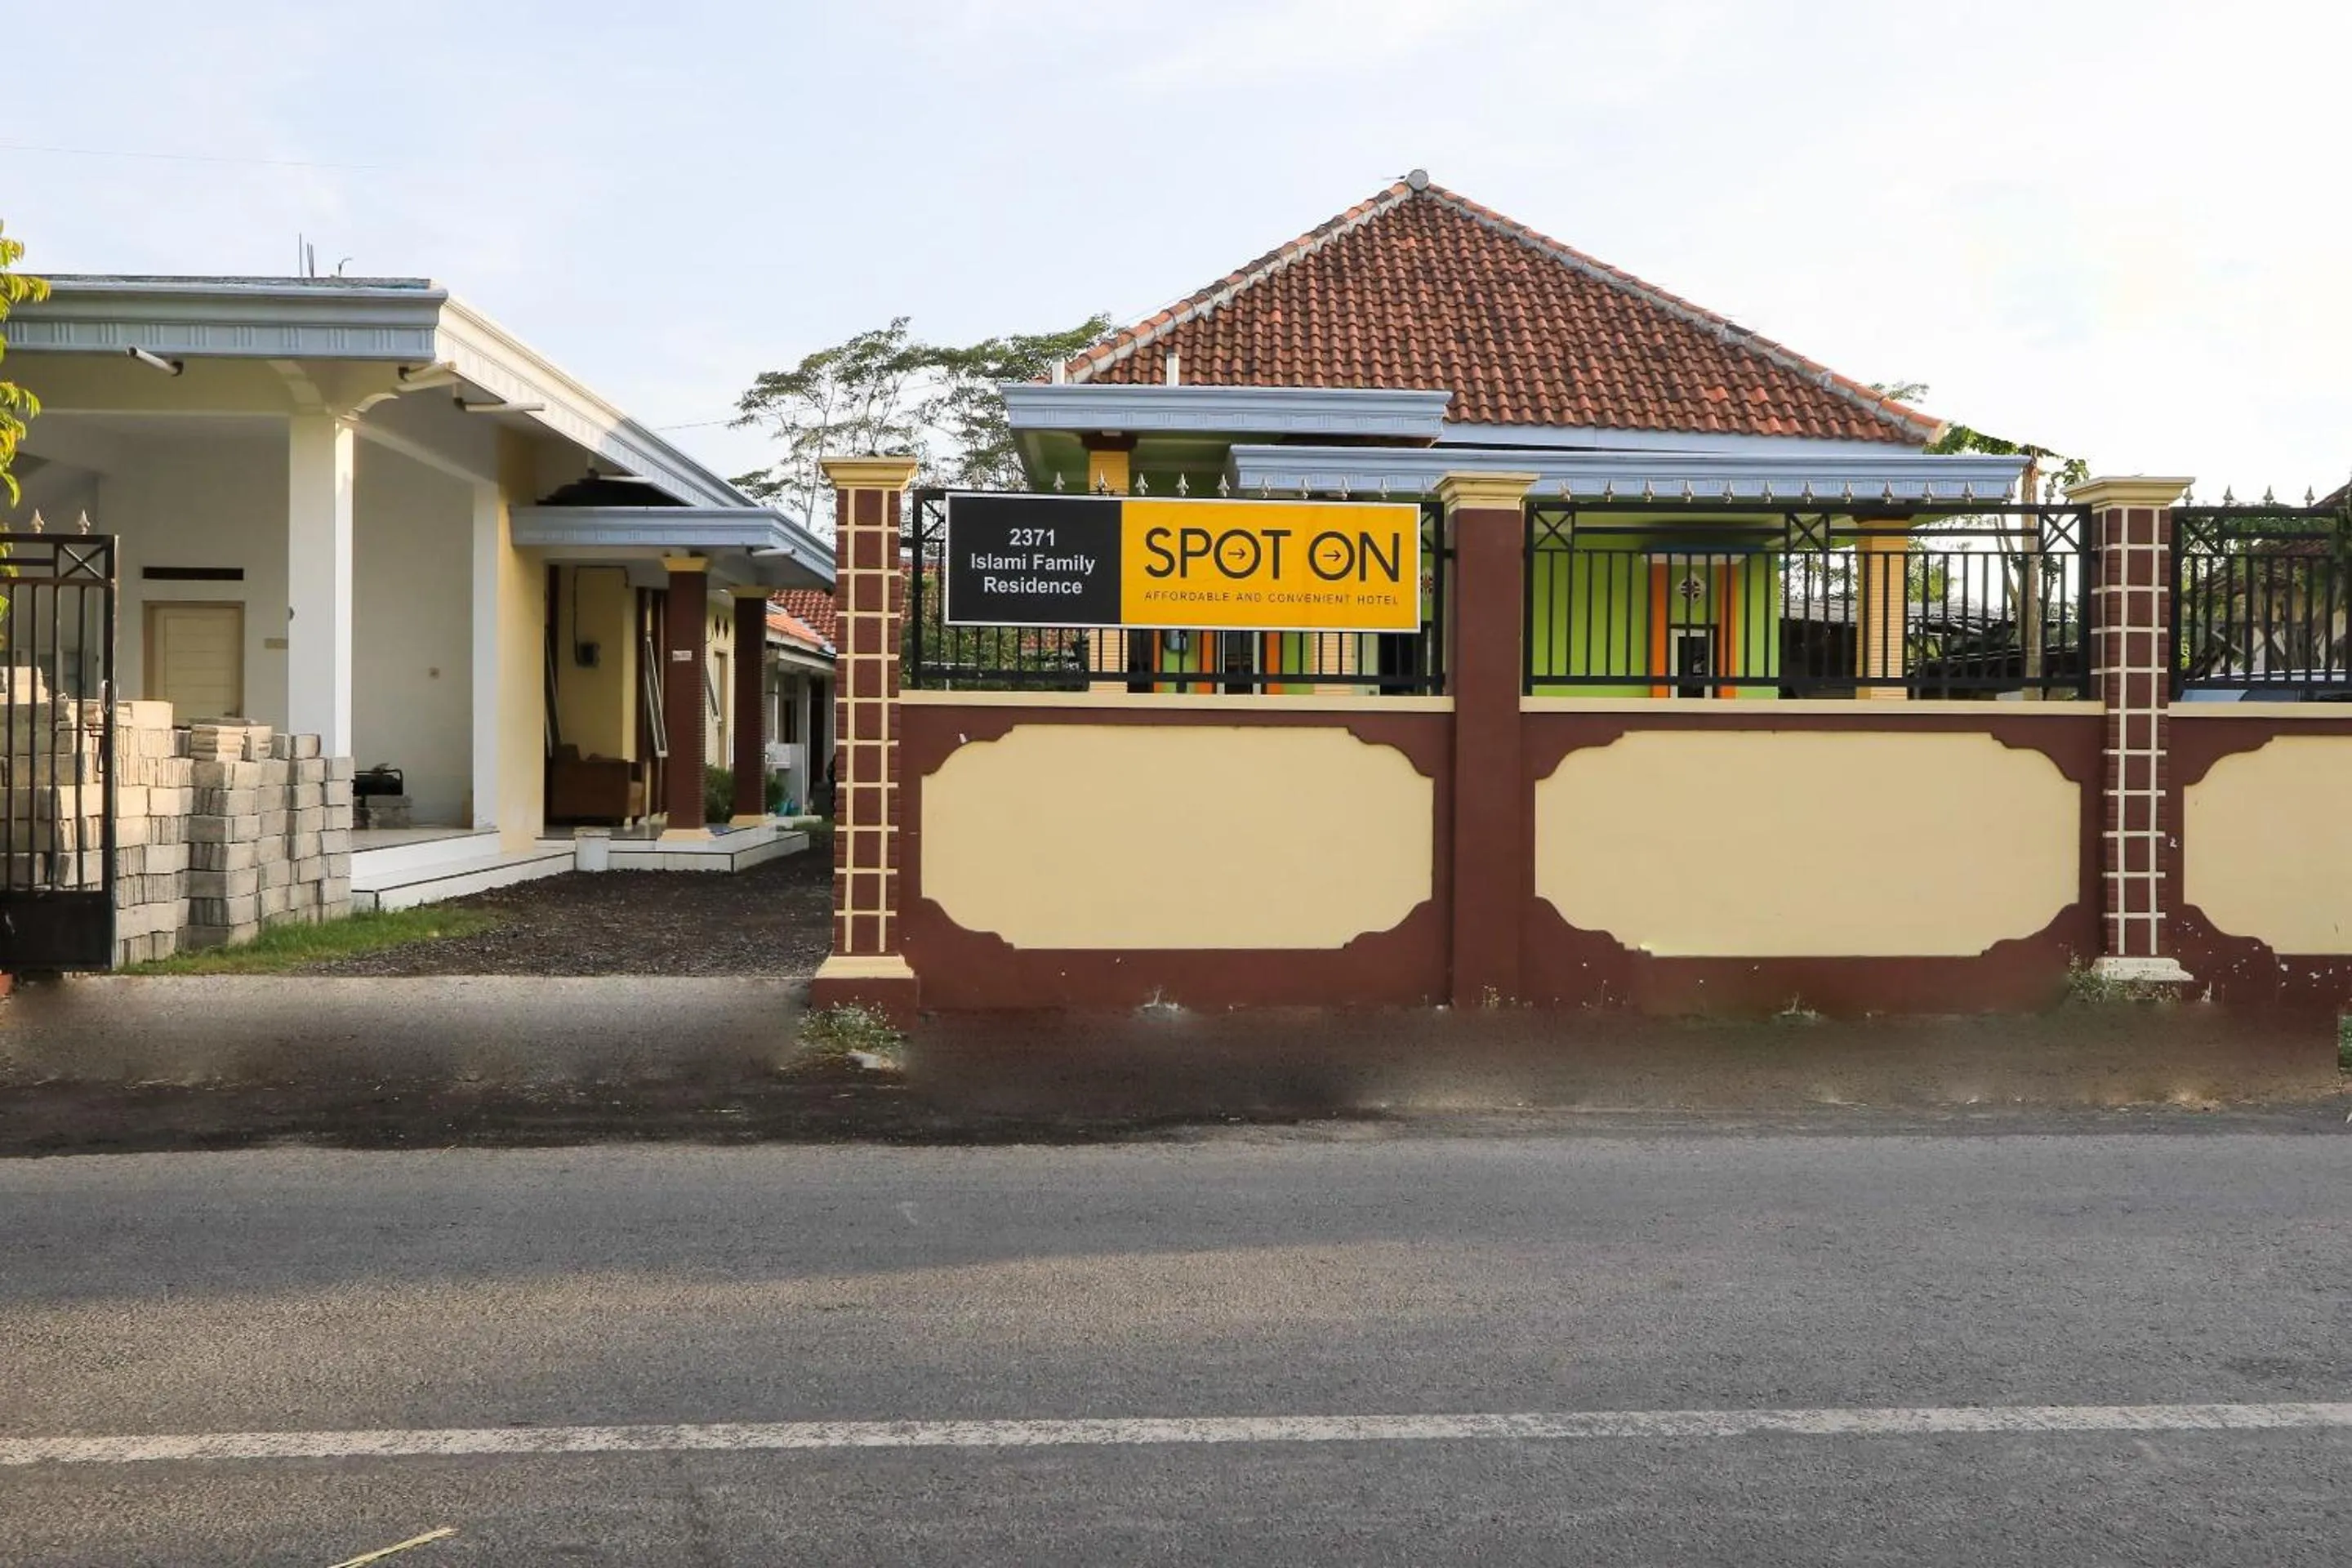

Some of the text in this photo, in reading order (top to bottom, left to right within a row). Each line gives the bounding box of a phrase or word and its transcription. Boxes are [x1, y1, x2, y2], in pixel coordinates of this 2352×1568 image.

[1009, 528, 1055, 547] 2371
[1144, 527, 1401, 582] SPOT ON
[970, 553, 1096, 576] Islami Family
[983, 576, 1083, 595] Residence
[1144, 590, 1400, 605] AFFORDABLE AND CONVENIENT HOTEL
